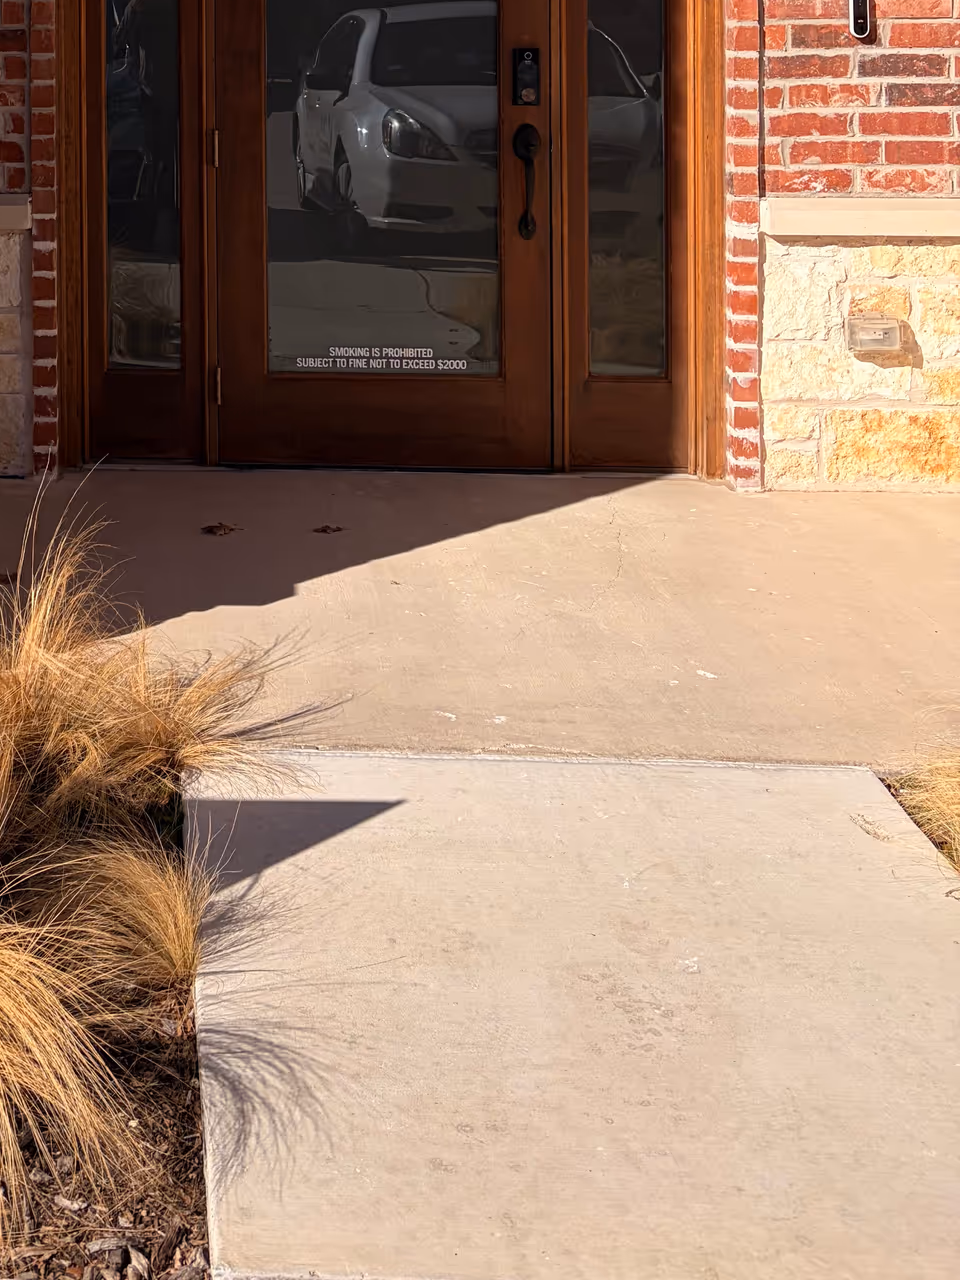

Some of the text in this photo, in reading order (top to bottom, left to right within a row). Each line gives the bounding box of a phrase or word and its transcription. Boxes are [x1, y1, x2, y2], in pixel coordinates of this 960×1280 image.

[328, 346, 433, 358] SMOKING IS PROHIBITED
[296, 357, 467, 370] SUBJECT TO FINE NOT TO EXCEED $2000
